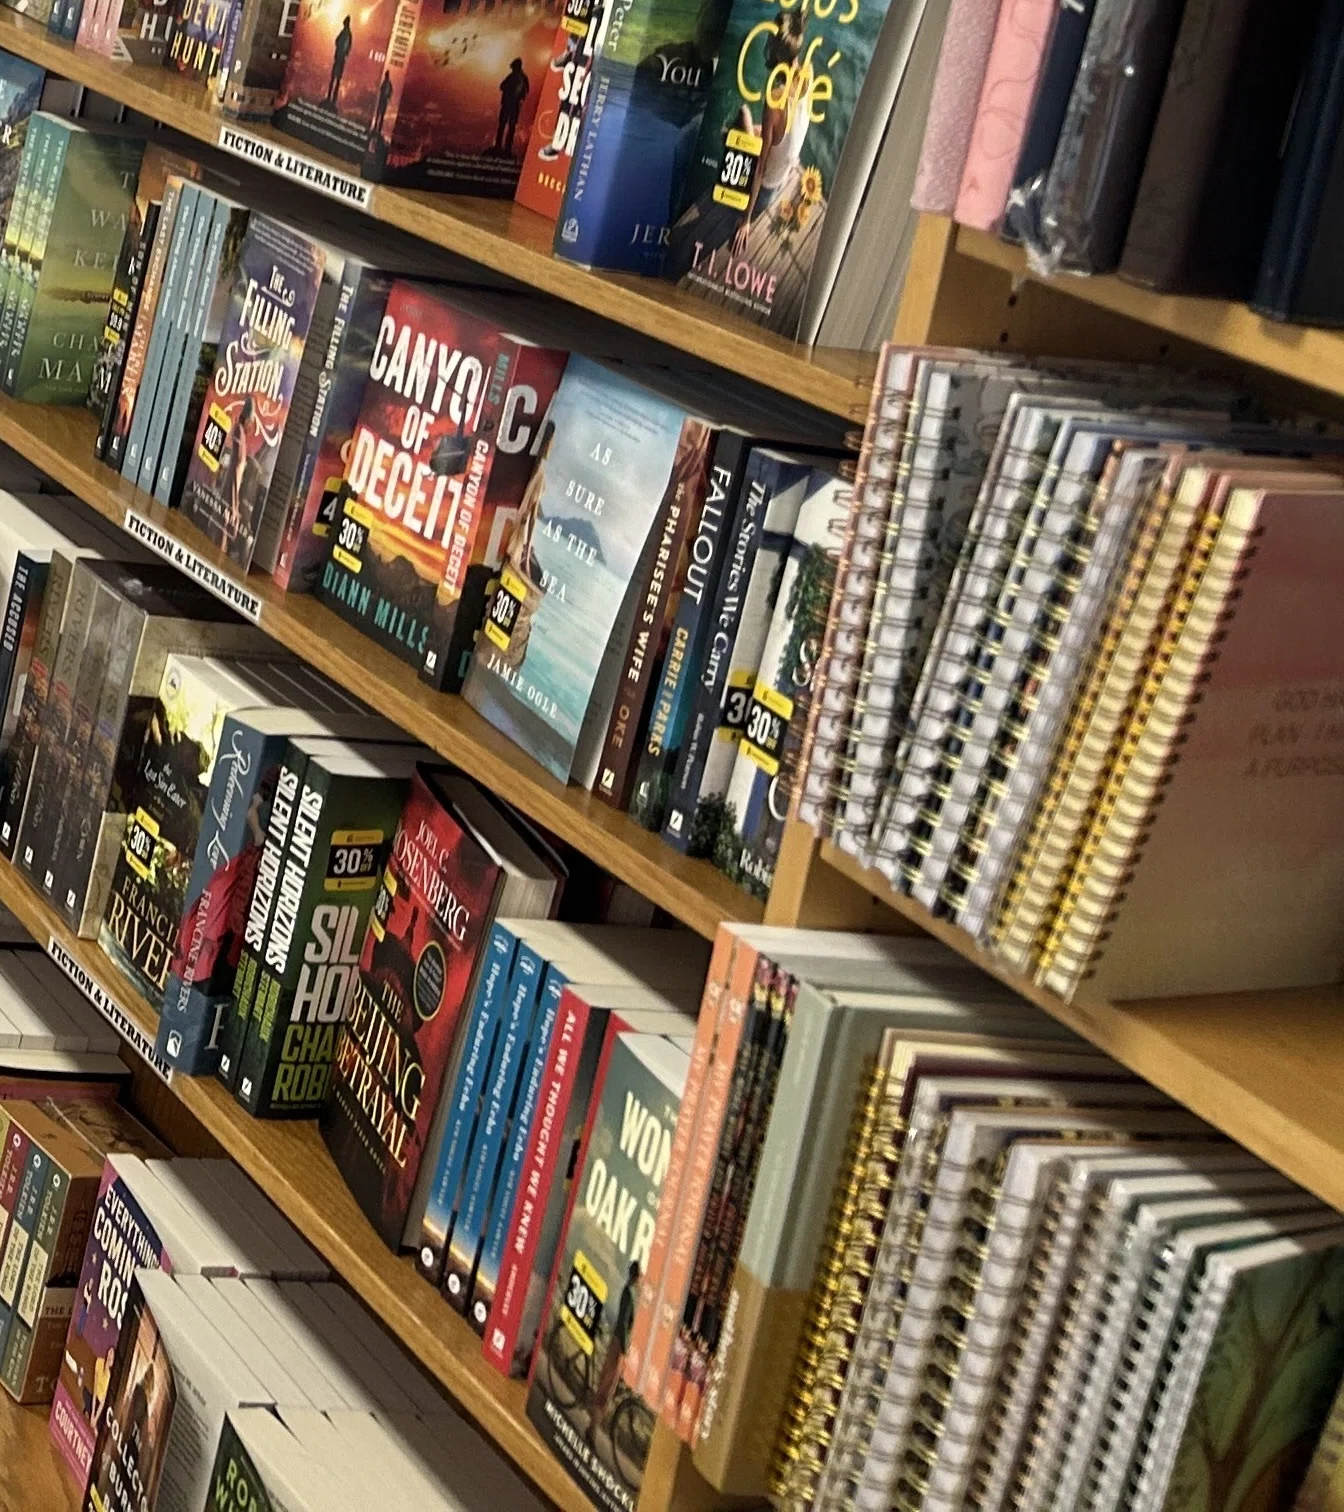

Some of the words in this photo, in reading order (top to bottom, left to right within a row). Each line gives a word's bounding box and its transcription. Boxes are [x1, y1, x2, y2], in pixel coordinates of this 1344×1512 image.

[737, 21, 840, 126] Café
[222, 131, 273, 166] FICTION
[285, 156, 368, 203] LITERATURE
[241, 280, 296, 351] FILLING
[214, 357, 284, 406] STATION
[400, 404, 436, 456] OF
[589, 444, 613, 467] AS
[350, 429, 462, 550] DECEIT
[565, 479, 605, 516] SURE
[744, 479, 766, 513] The
[542, 521, 563, 542] AS
[567, 532, 599, 567] THE
[683, 465, 731, 606] FALLOUT
[728, 515, 759, 591] Stories
[128, 516, 173, 560] FICTION
[184, 552, 259, 617] LITERATURE
[539, 573, 569, 603] SEA
[3, 596, 24, 652] ACCUSED
[323, 563, 369, 615] DIANN
[372, 603, 430, 655] MILLS
[718, 595, 740, 628] We
[701, 632, 729, 695] Carry
[611, 706, 631, 749] OKE
[268, 766, 299, 849] SILENT
[289, 784, 323, 869] SILENT
[333, 848, 373, 876] 30%
[244, 848, 282, 952] HORIZONS
[265, 868, 305, 974] HORIZONS
[381, 982, 403, 1025] THE
[563, 1009, 575, 1041] ALL
[556, 1047, 569, 1077] WE
[532, 1080, 559, 1166] THOUGHT
[526, 1168, 540, 1198] WE
[514, 1204, 533, 1254] KNEW
